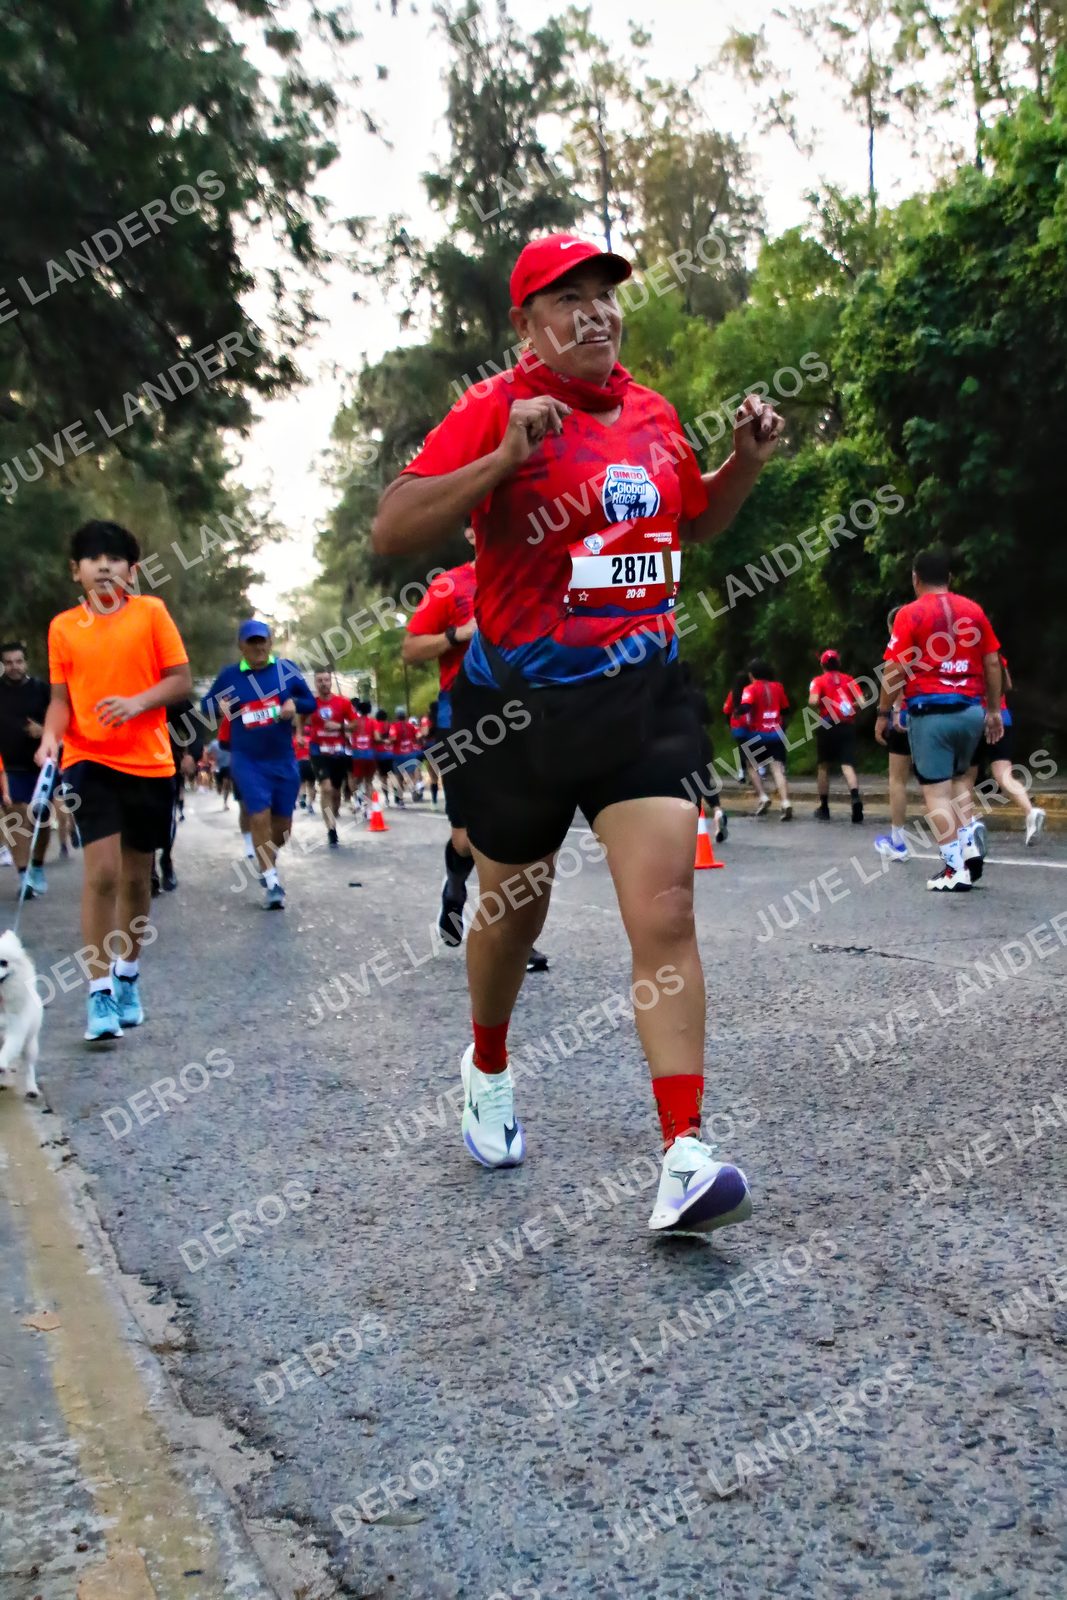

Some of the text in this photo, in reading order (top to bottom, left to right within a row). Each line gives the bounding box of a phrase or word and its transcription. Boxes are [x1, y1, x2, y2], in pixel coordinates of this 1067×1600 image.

[617, 482, 647, 495] Global
[612, 493, 637, 505] Race
[612, 555, 658, 585] 2874
